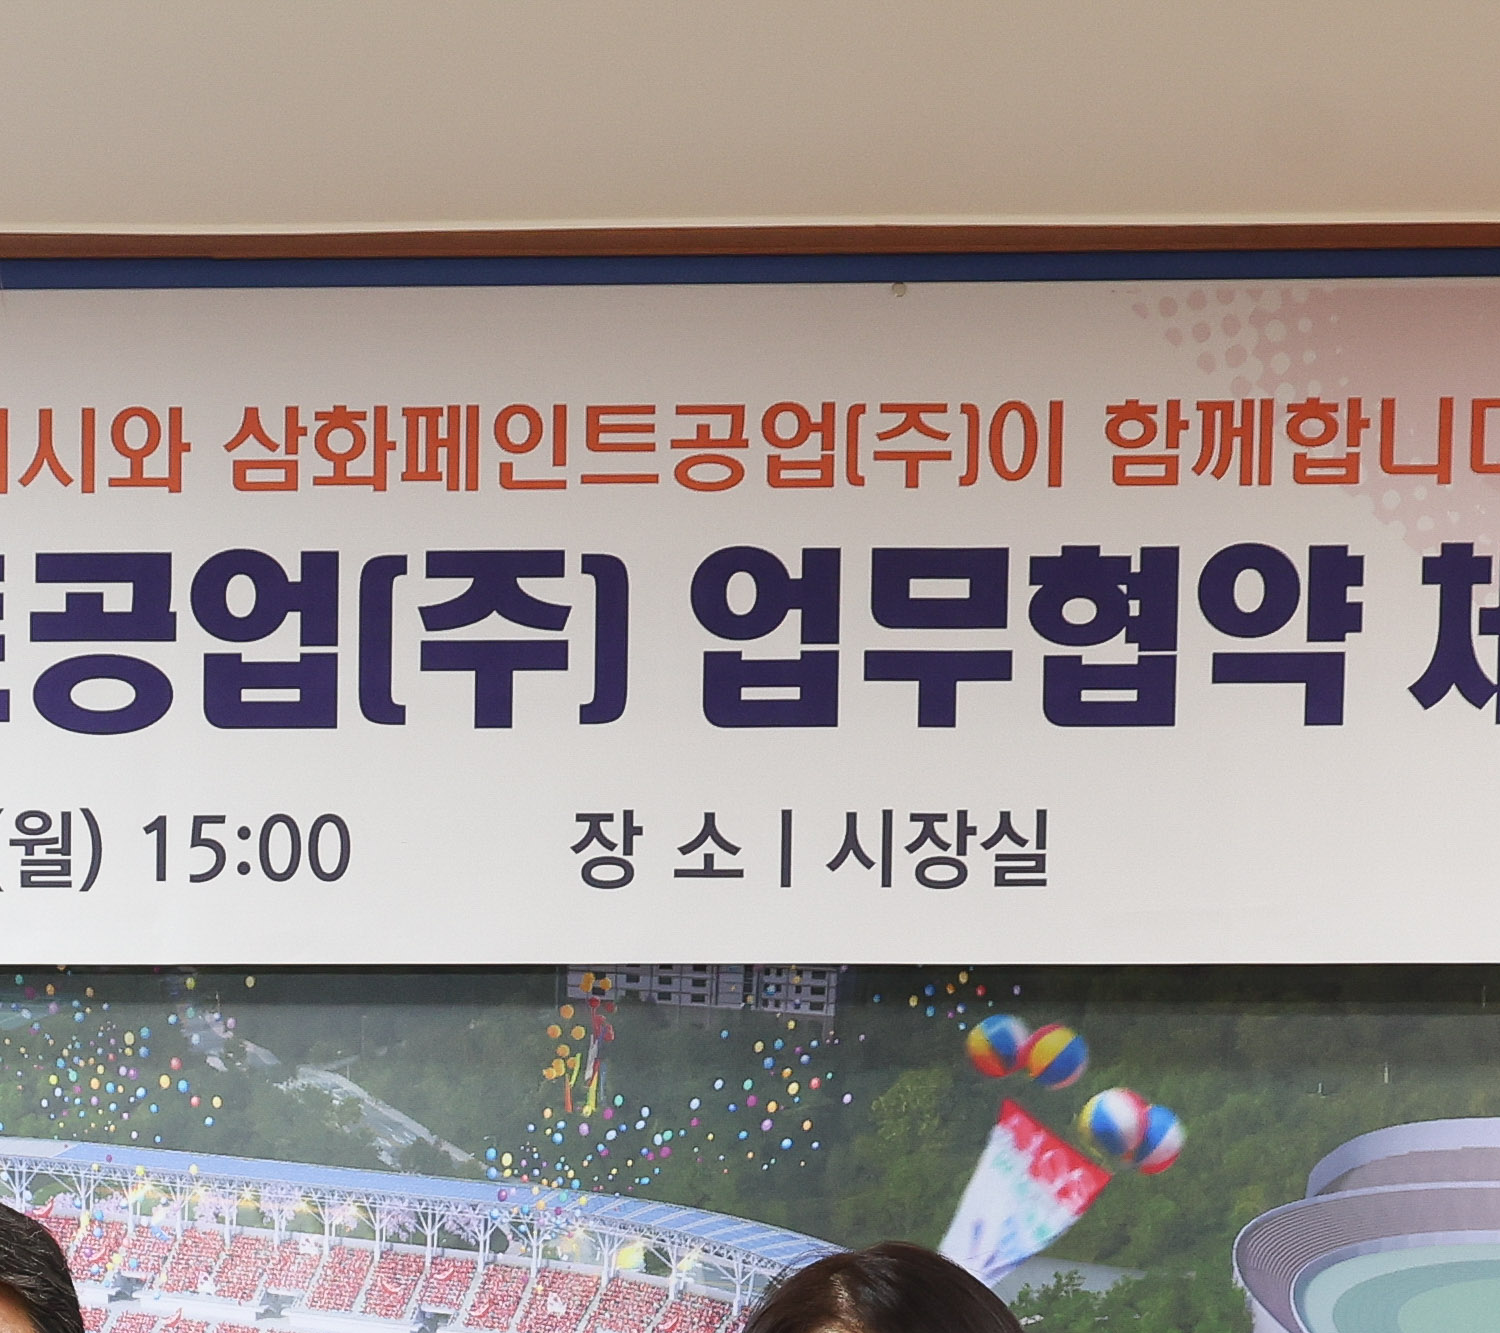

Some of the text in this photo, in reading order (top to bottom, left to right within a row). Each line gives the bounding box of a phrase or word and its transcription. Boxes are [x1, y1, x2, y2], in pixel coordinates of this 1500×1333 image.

[224, 400, 1064, 492] 삼화페인트공업(주)이
[690, 543, 1364, 728] 업무협약
[143, 814, 350, 883] 15:00
[826, 809, 1047, 889] 시장실
